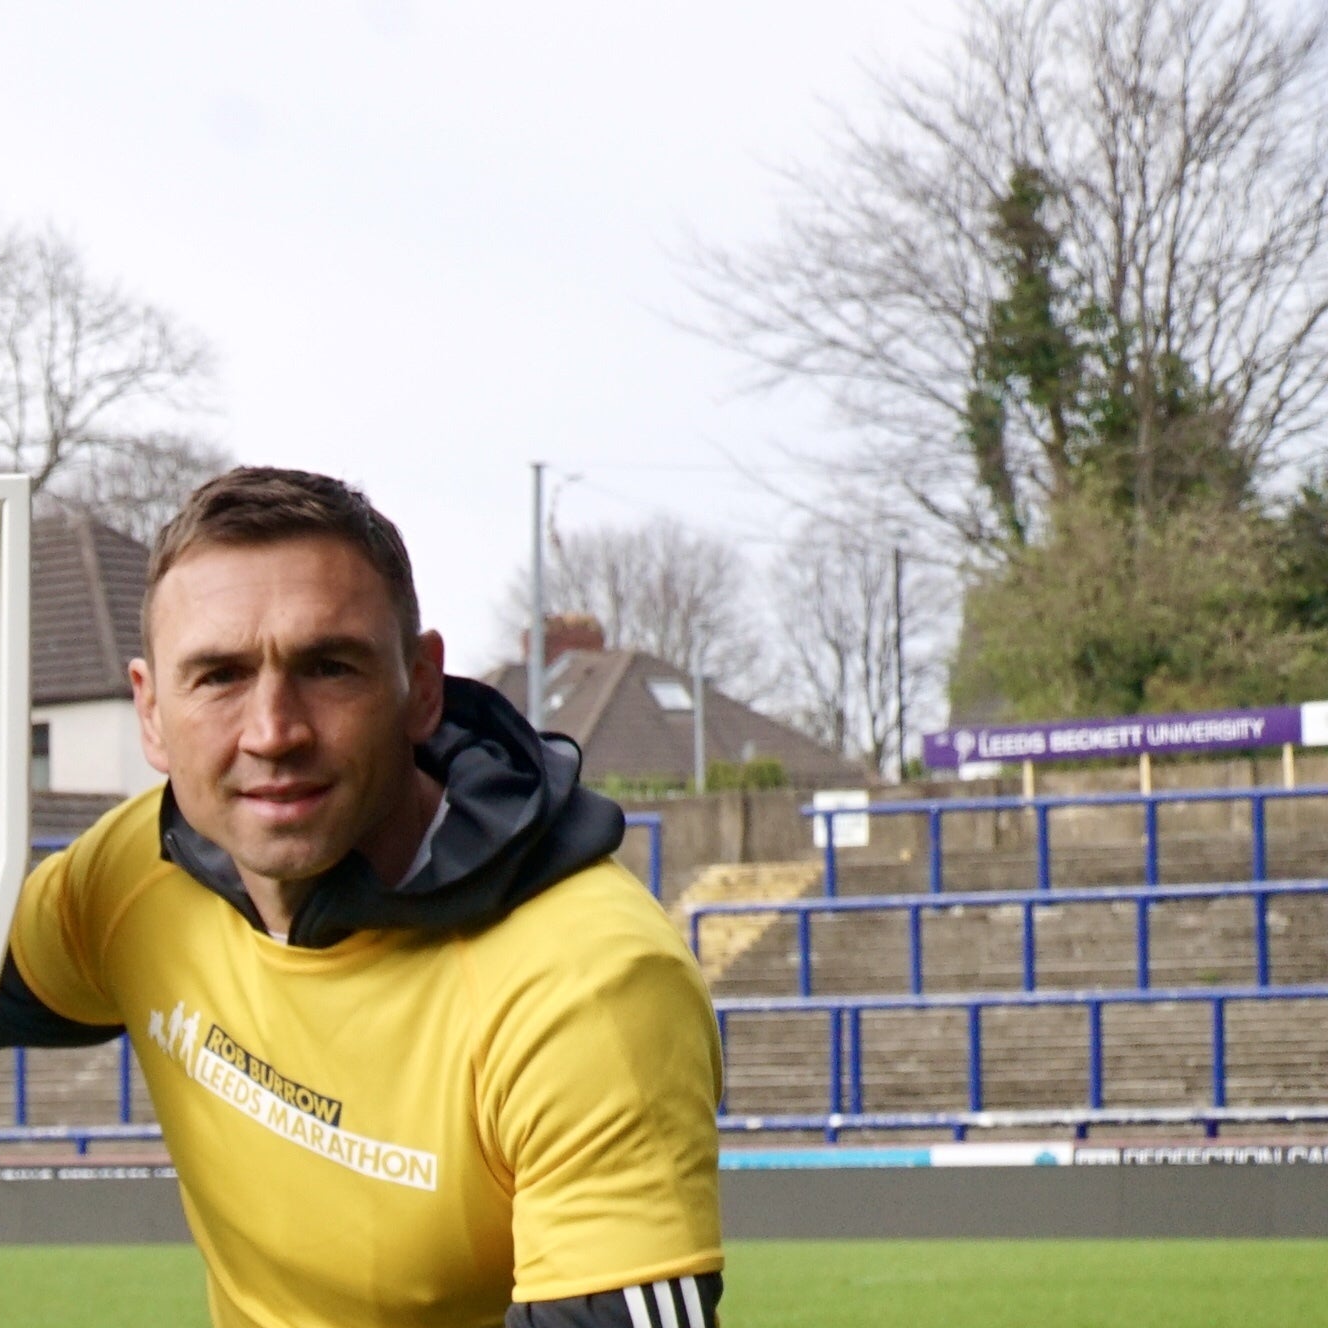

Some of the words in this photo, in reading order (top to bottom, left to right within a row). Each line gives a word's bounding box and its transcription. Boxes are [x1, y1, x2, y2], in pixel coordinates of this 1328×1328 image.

[1146, 717, 1265, 747] UNIVERSITY
[199, 1054, 264, 1116] LEEDS
[266, 1101, 433, 1186] MARATHON
[207, 1026, 246, 1071] ROB
[247, 1061, 340, 1125] BURROW
